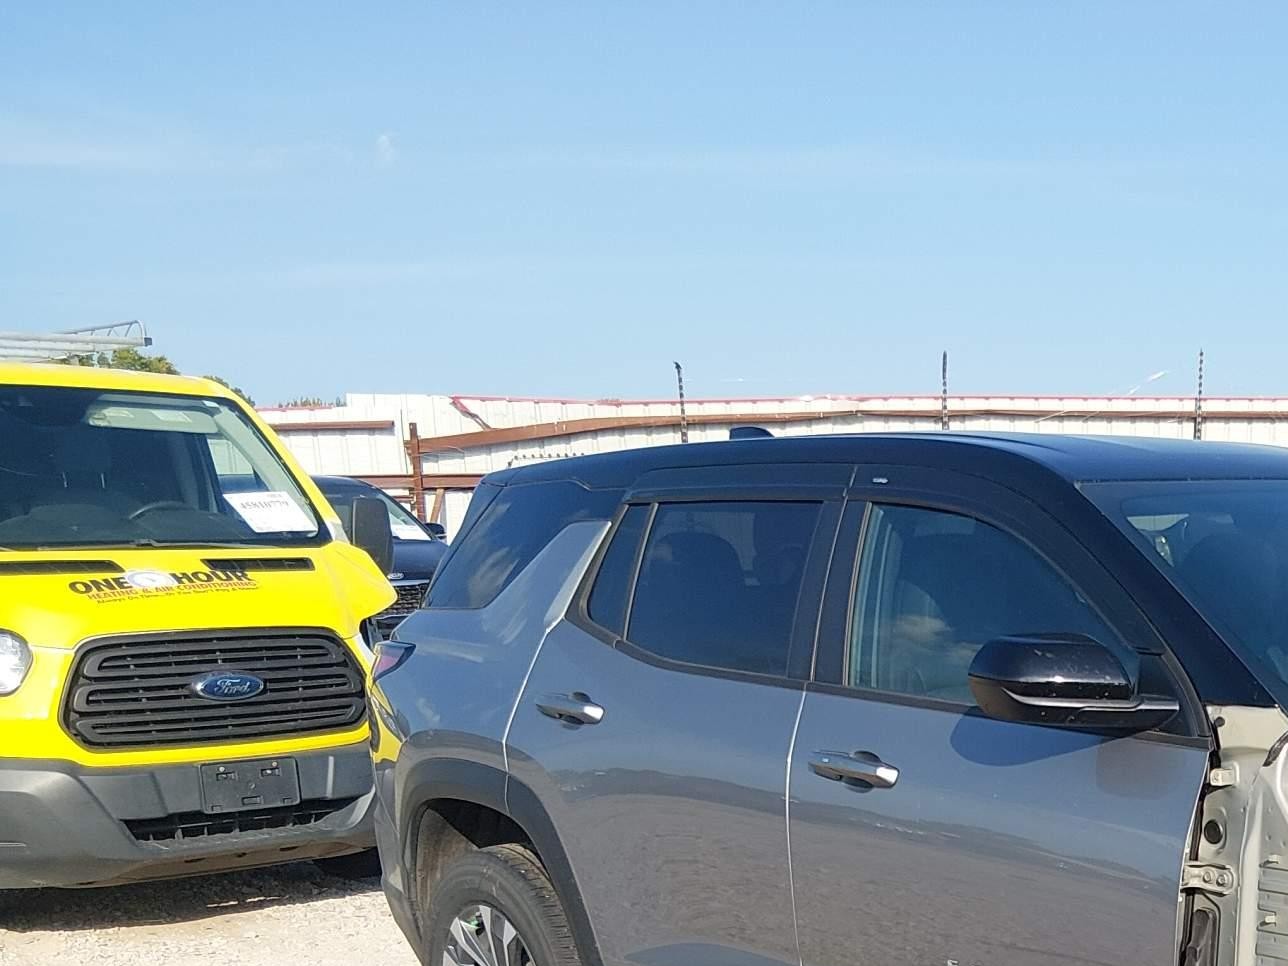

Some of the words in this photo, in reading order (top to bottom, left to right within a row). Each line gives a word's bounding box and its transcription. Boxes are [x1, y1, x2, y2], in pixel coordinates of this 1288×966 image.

[68, 576, 133, 595] ONE
[169, 570, 251, 585] HOUR
[87, 588, 139, 601] HEATING
[154, 586, 174, 594] AIR
[176, 580, 257, 592] CONDITIONING
[214, 679, 251, 695] Ford
